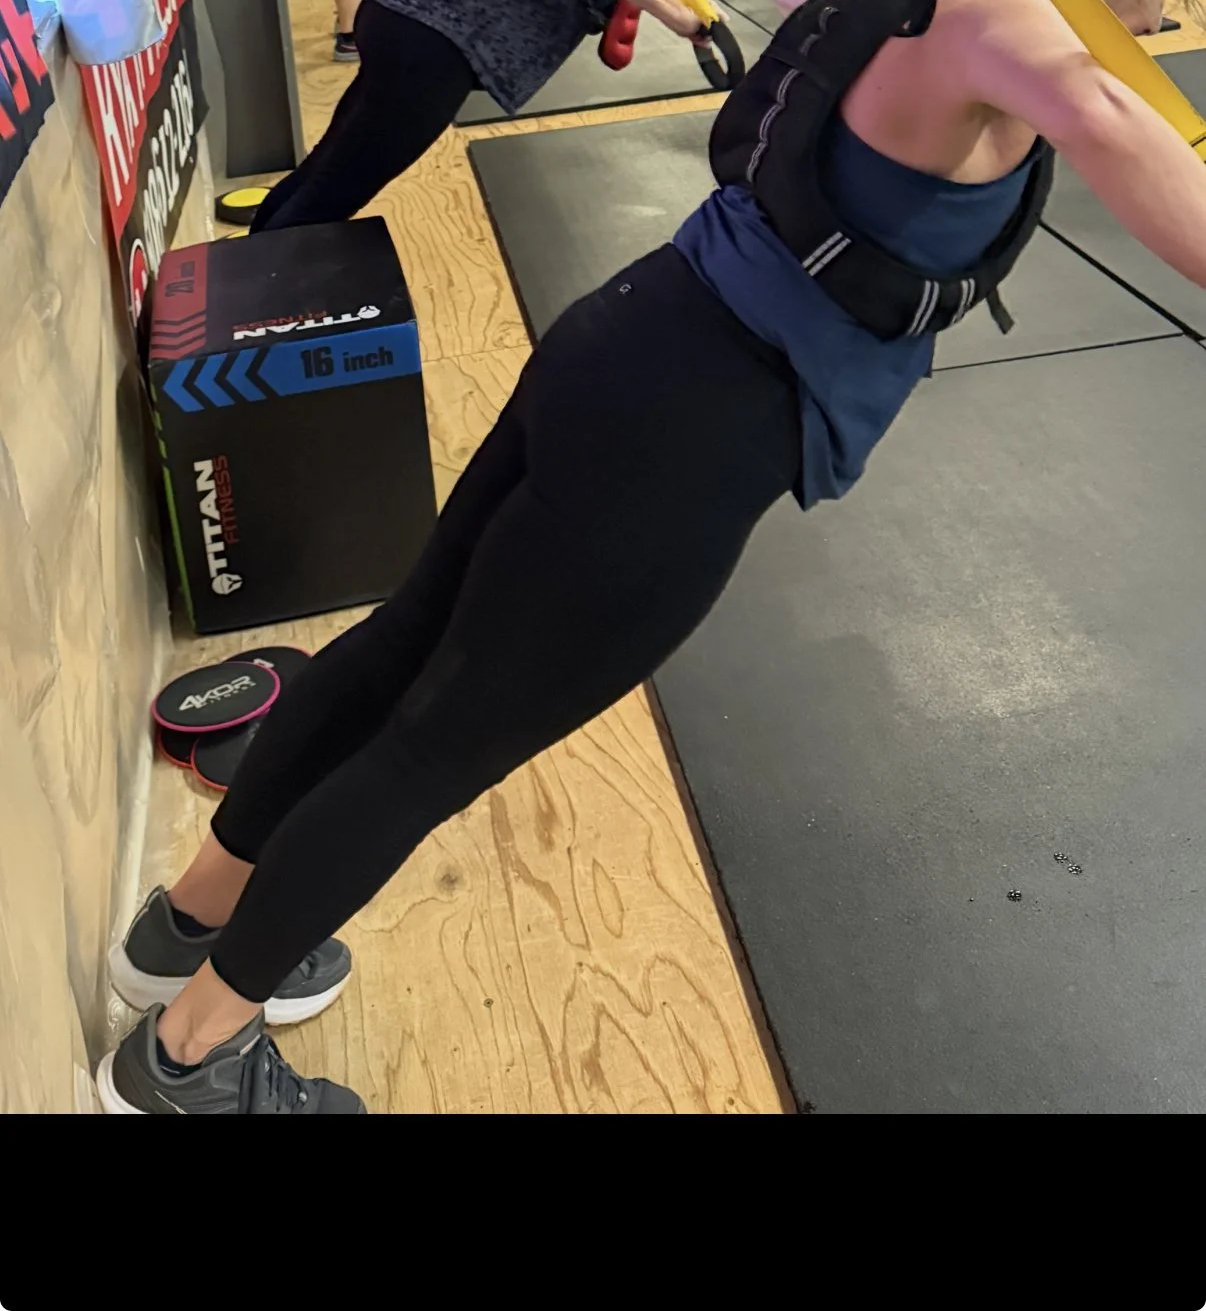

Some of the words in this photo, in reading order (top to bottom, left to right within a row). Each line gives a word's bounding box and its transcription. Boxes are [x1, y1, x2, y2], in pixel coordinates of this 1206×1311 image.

[233, 313, 361, 340] TITAN
[301, 346, 334, 379] 16
[343, 346, 394, 373] inch
[193, 459, 228, 579] TITAN
[212, 455, 239, 545] FITNESS
